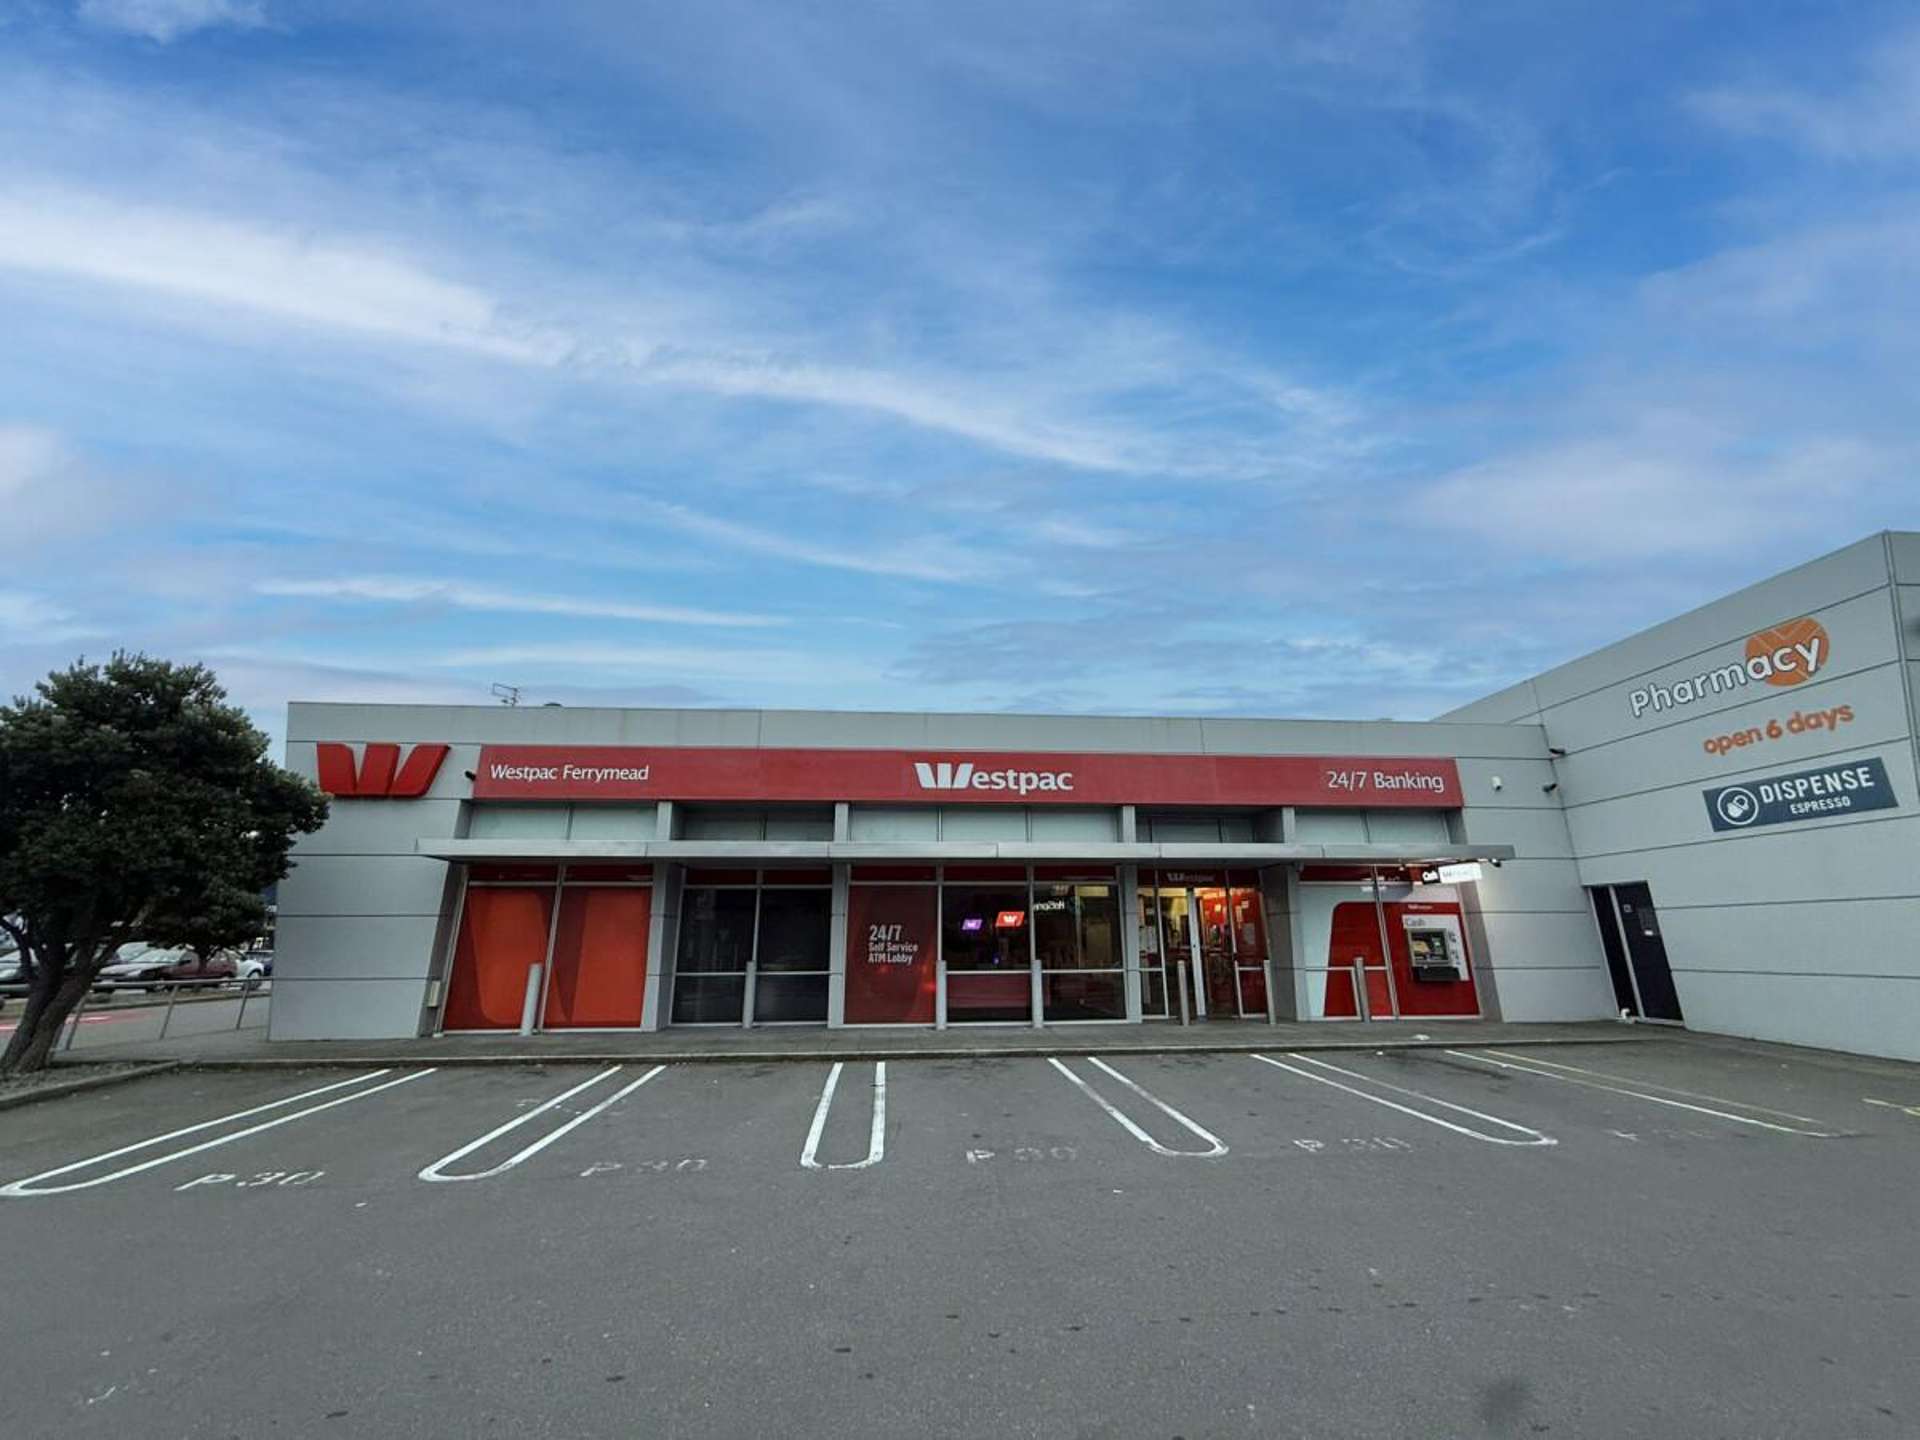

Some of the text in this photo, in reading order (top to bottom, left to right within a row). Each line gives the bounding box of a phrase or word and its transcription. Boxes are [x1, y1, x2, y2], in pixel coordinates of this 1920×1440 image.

[1629, 637, 1821, 718] Pharmacy
[1703, 704, 1855, 756] open 6 days
[490, 764, 649, 783] Westpac Ferrymead
[914, 762, 1074, 795] Westpac
[1326, 771, 1445, 793] 24/7 Banking
[1759, 767, 1875, 804] DISPENSE
[1790, 796, 1851, 815] ESPRESSO
[869, 924, 902, 941] 24/7
[868, 941, 919, 953] Self Service
[867, 953, 913, 966] ATM Lobby
